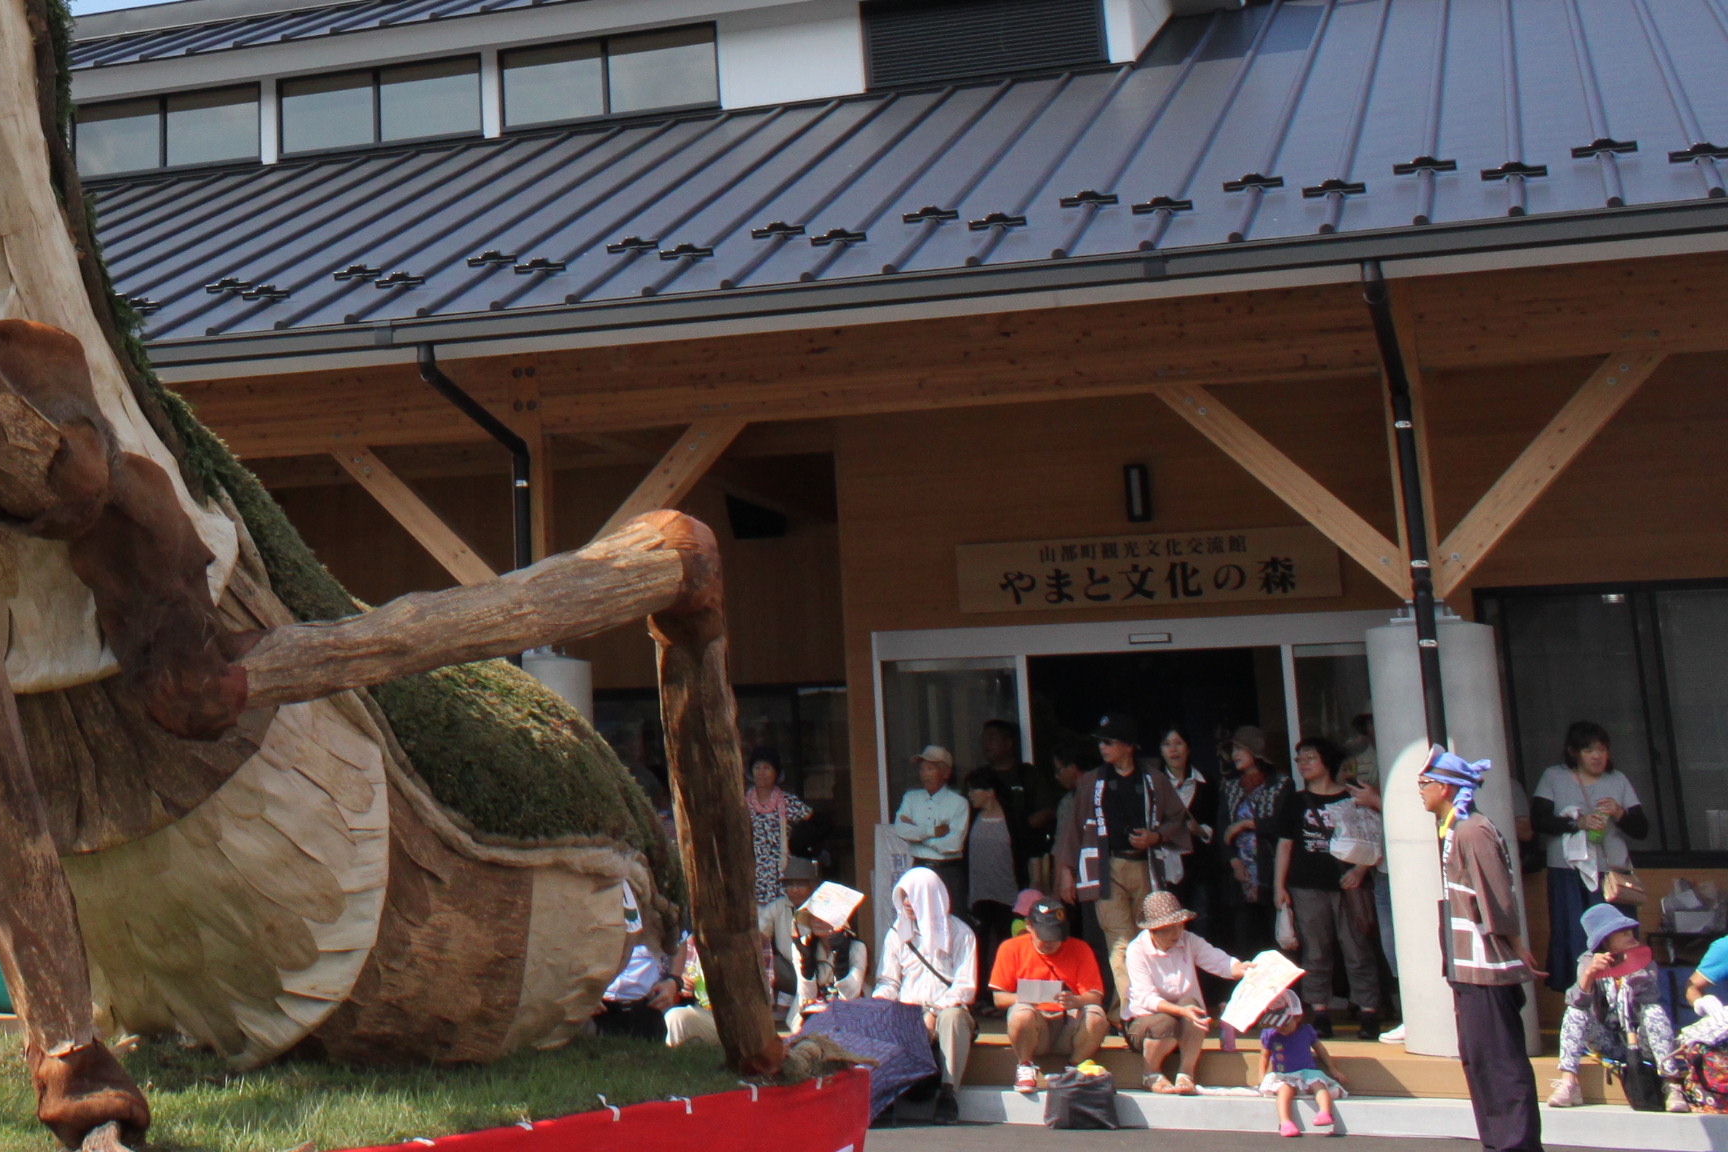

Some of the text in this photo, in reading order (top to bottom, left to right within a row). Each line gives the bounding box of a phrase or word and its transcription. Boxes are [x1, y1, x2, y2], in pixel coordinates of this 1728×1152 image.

[1040, 535, 1248, 563] 山都町観光文化交流館
[999, 556, 1297, 605] やまと文化の森
